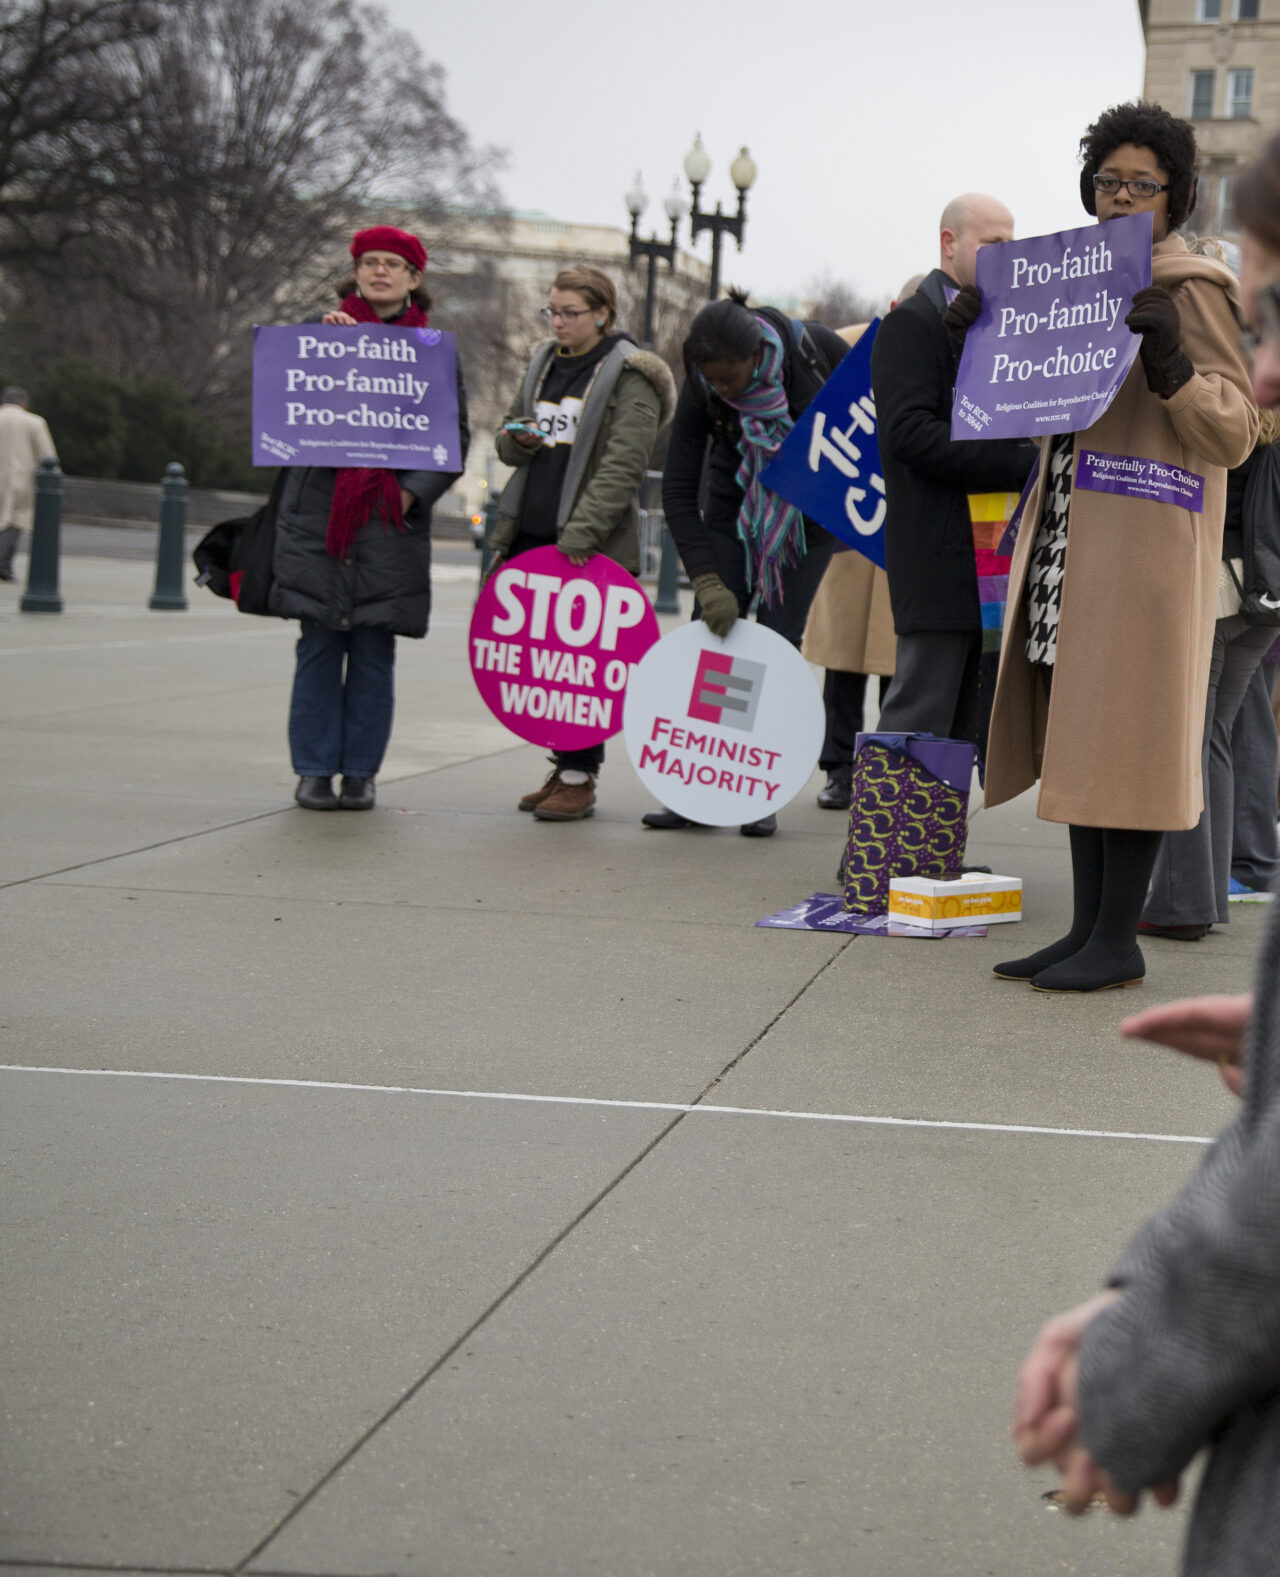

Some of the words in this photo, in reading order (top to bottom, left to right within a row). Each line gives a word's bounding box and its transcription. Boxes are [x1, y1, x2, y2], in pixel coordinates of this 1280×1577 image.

[1010, 241, 1113, 289] Pro-faith
[997, 289, 1123, 338] Pro-family
[297, 335, 418, 363] Pro-faith
[988, 342, 1117, 384] Pro-choice
[285, 368, 429, 404] Pro-family
[995, 402, 1022, 413] Religious
[1023, 400, 1049, 410] Coalition
[1049, 398, 1057, 407] for
[1057, 394, 1091, 407] Reproductive
[285, 402, 430, 431] Pro-choice
[958, 408, 966, 418] to
[960, 395, 975, 412] Text
[972, 406, 993, 426] RCRC
[1086, 454, 1146, 475] Prayerfully
[1148, 463, 1200, 489] Pro-Choice
[1092, 471, 1115, 481] Religious
[1116, 474, 1137, 483] Coalition
[1138, 477, 1146, 485] for
[492, 568, 645, 651] STOP
[473, 637, 523, 675] THE
[529, 646, 597, 688] WAR
[604, 659, 639, 692] O
[500, 681, 613, 730] WOMEN
[651, 716, 782, 771] FEMINIST
[638, 744, 781, 801] MAJORITY
